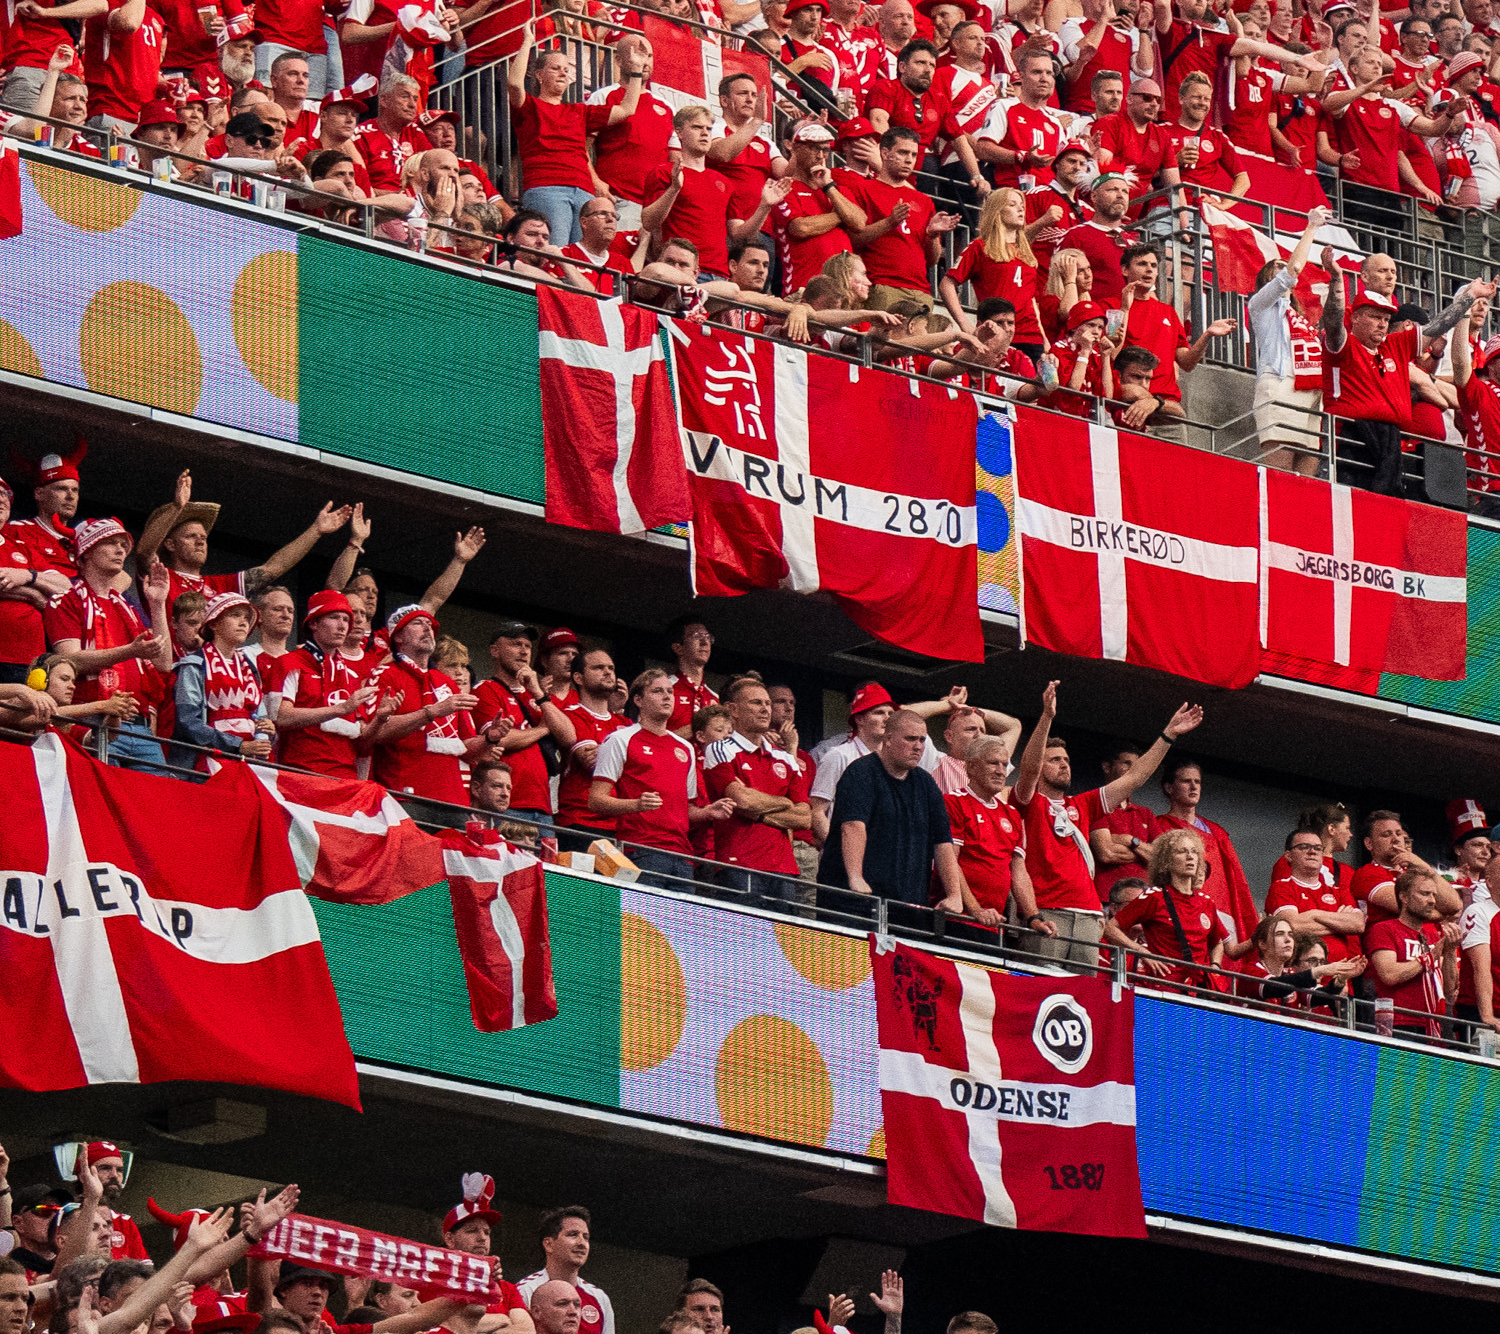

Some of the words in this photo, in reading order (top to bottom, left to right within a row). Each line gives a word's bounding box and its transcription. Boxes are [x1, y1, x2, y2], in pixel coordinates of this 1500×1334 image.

[142, 24, 156, 47] 21
[1070, 516, 1185, 564] BIRKERØD
[1295, 551, 1394, 591] JÆGERSBORG
[1403, 575, 1426, 598] BK
[1044, 1017, 1083, 1048] OB
[950, 1077, 1071, 1121] ODENSE
[1043, 1163, 1105, 1191] 1887
[372, 1236, 491, 1294] MAFIA
